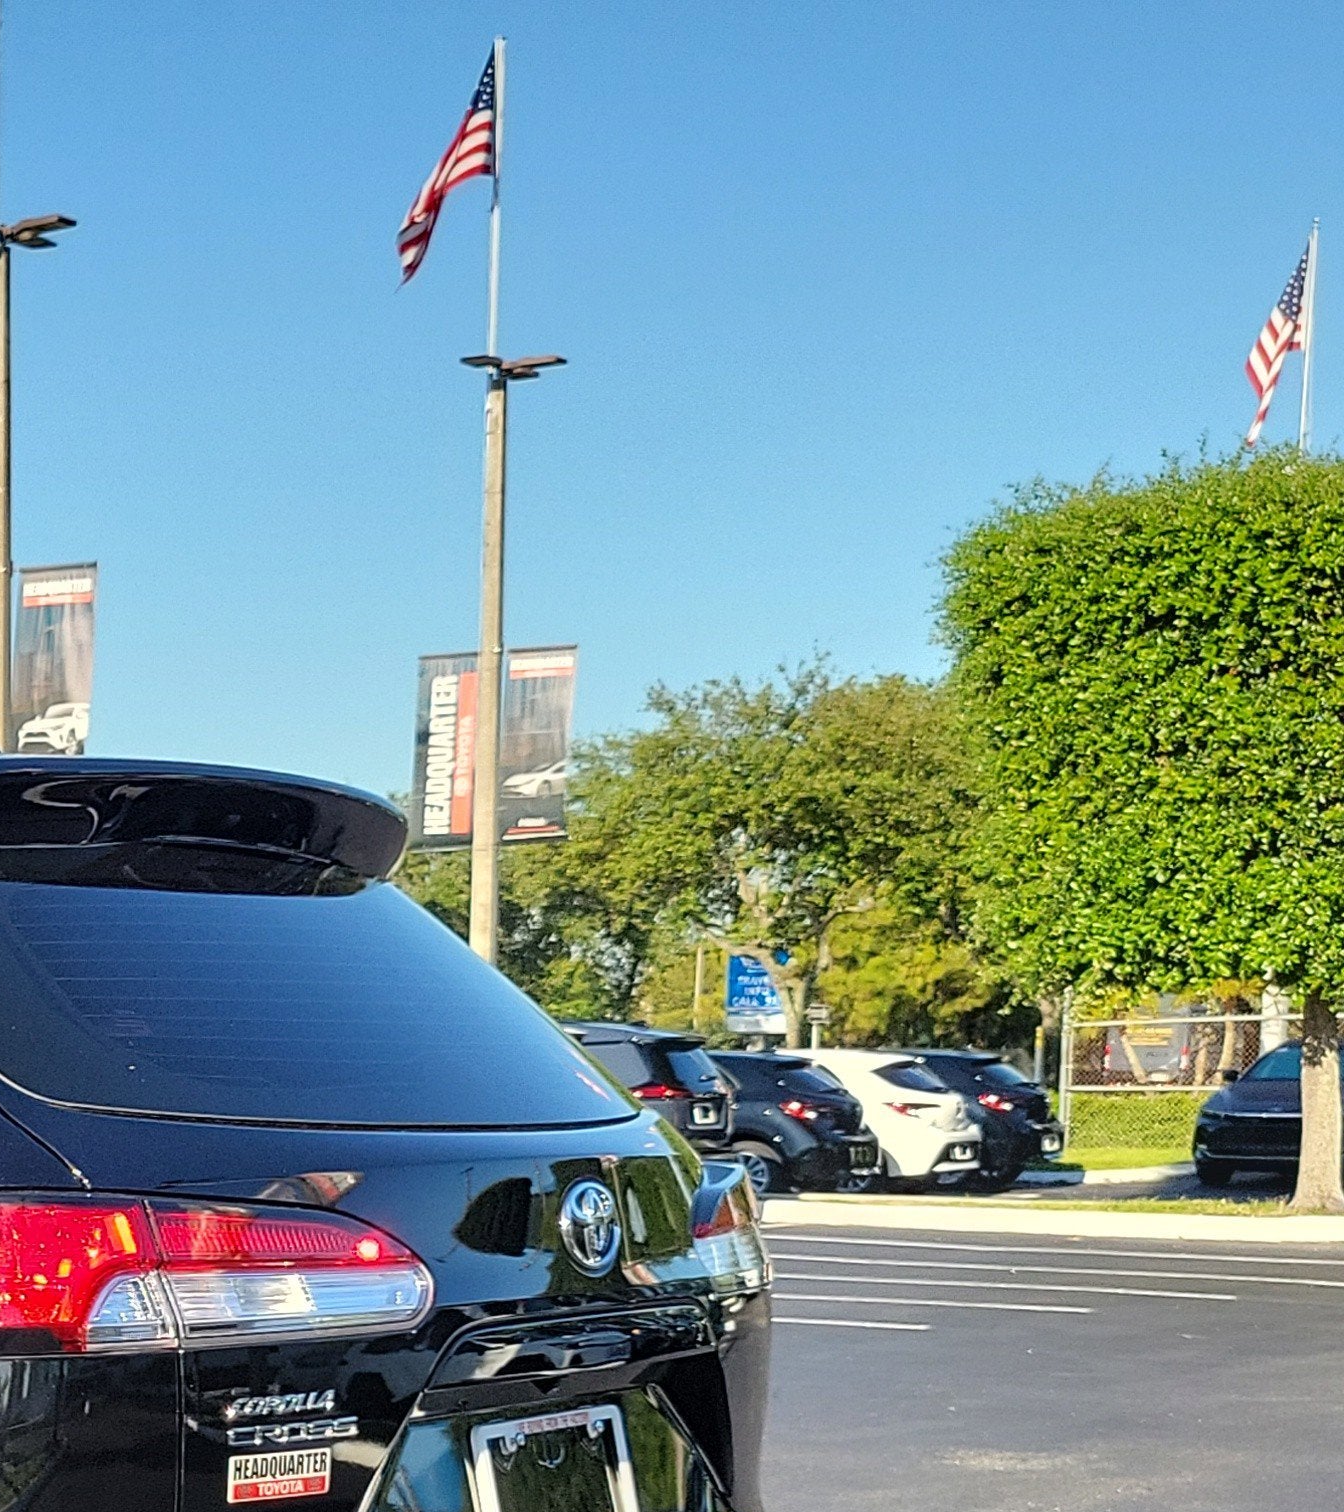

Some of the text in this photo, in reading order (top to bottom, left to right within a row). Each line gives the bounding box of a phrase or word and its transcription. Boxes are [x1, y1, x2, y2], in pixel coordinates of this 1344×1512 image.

[226, 1390, 336, 1417] COROLLA
[226, 1416, 359, 1446] CROSS
[233, 1452, 328, 1481] HEADQUARTER
[257, 1480, 305, 1496] TOYOTA
